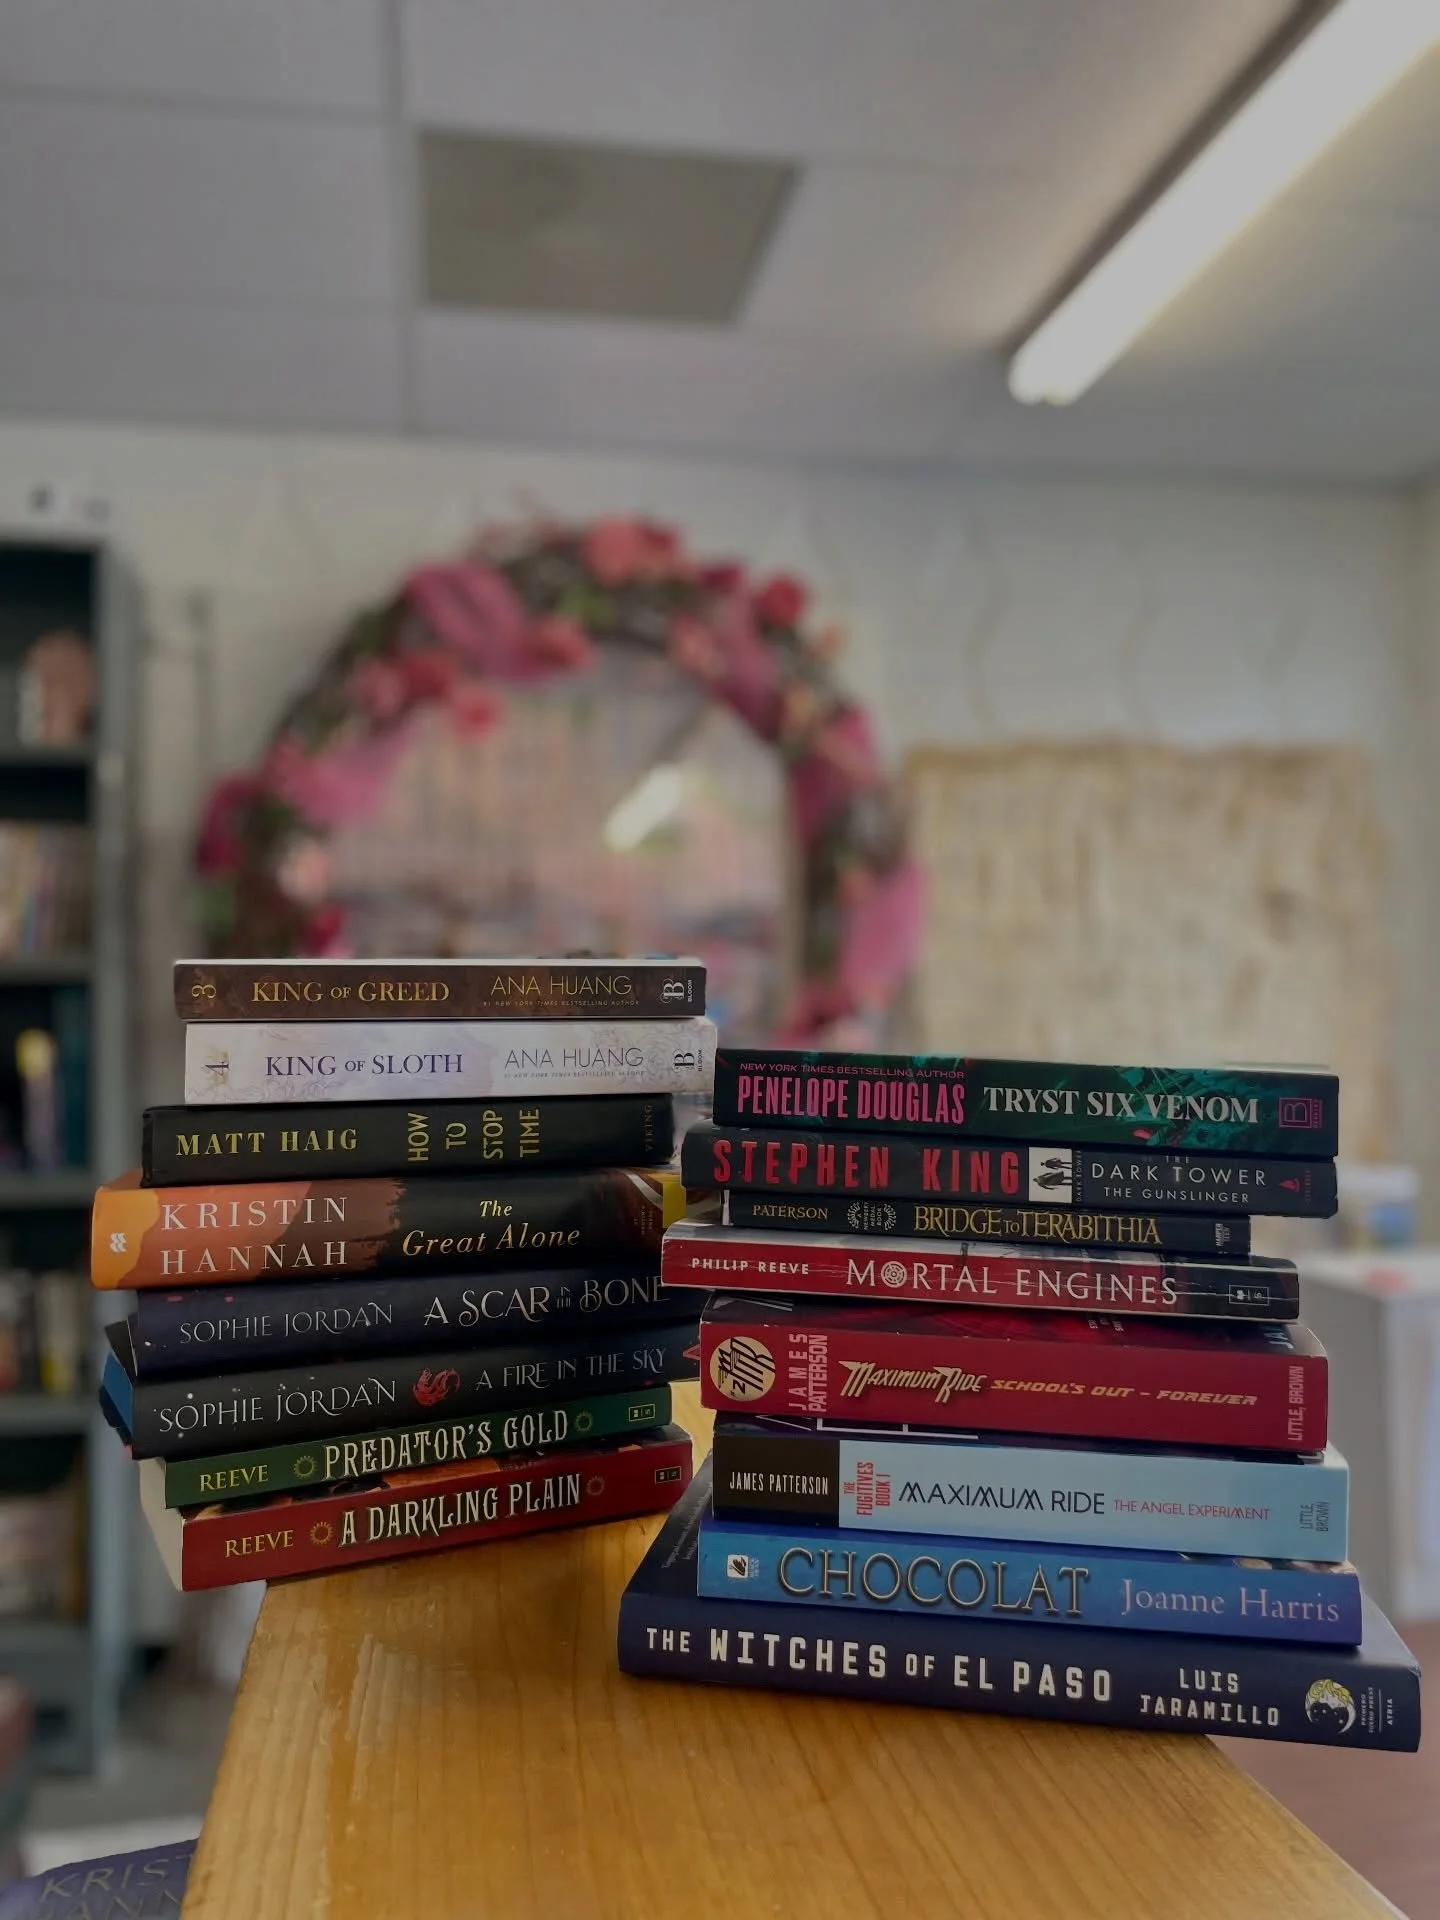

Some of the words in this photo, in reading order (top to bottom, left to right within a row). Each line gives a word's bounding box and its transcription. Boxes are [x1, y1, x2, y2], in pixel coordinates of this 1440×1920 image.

[191, 983, 216, 999] 3
[252, 981, 323, 1002] KING
[330, 986, 351, 999] OF
[358, 981, 449, 1002] GREED
[491, 976, 541, 996] ANA
[550, 975, 632, 996] HUANG
[204, 1061, 229, 1076] 4
[266, 1056, 336, 1076] KING
[344, 1060, 366, 1072] OF
[371, 1054, 462, 1075] SLOTH
[505, 1049, 553, 1069] ANA
[563, 1048, 644, 1068] HUANG
[740, 1062, 767, 1072] NEW
[769, 1063, 798, 1073] YORK
[802, 1065, 834, 1075] TIMES
[837, 1067, 914, 1078] BESTSELLING
[916, 1069, 965, 1080] AUTHOR
[737, 1075, 849, 1119] PENELOPE
[857, 1080, 965, 1126] DOUGLAS
[984, 1087, 1080, 1115] TRYST
[1086, 1090, 1136, 1118] SIX
[1144, 1094, 1259, 1124] VENOM
[176, 1132, 265, 1156] MATT
[280, 1128, 358, 1152] HAIG
[408, 1112, 429, 1162] HOW
[445, 1121, 467, 1150] TO
[483, 1109, 504, 1160] STOP
[520, 1107, 540, 1158] TIME
[712, 1139, 890, 1190] STEPHEN
[922, 1148, 1019, 1195] KING
[1092, 1162, 1158, 1181] DARK
[1172, 1166, 1266, 1186] TOWER
[480, 1200, 513, 1217] The
[1104, 1186, 1132, 1198] THE
[1141, 1188, 1250, 1203] GUNSLINGER
[161, 1197, 347, 1231] KRISTIN
[752, 1204, 829, 1221] PATERSON
[913, 1205, 1002, 1237] BRIDGE
[1017, 1209, 1163, 1245] TERABITHIA
[402, 1229, 488, 1257] Great
[496, 1222, 581, 1250] Alone
[160, 1241, 347, 1275] HANNAH
[692, 1257, 748, 1272] PHILIP
[758, 1260, 809, 1275] REEVE
[846, 1258, 998, 1294] MORTAL
[1016, 1267, 1178, 1305] ENGINES
[424, 1296, 450, 1326] A
[458, 1286, 550, 1327] SCAR
[580, 1276, 670, 1313] BONE
[180, 1315, 273, 1345] SOPHIE
[284, 1302, 392, 1338] JORDAN
[475, 1369, 494, 1392] A
[503, 1362, 550, 1389] FIRE
[557, 1358, 577, 1380] IN
[585, 1352, 625, 1376] THE
[632, 1348, 667, 1374] SKY
[788, 1333, 808, 1411] JAMES
[808, 1334, 828, 1413] PATTERSON
[838, 1360, 942, 1398] MAXIMUM
[933, 1366, 988, 1404] RIDE
[990, 1378, 1086, 1395] SCHOOL'S
[1090, 1386, 1134, 1399] OUT
[1156, 1390, 1258, 1407] FOREVER
[1288, 1365, 1304, 1404] BROWN
[159, 1396, 264, 1433] SOPHIE
[277, 1378, 396, 1422] JORDAN
[200, 1464, 269, 1492] REEVE
[321, 1420, 493, 1482] PREDATOR'S
[503, 1409, 569, 1450] GOLD
[730, 1471, 764, 1492] JAMES
[769, 1473, 829, 1496] PATTERSON
[844, 1481, 855, 1495] THE
[856, 1462, 874, 1517] FUGITIVES
[875, 1481, 890, 1506] BOOK
[898, 1481, 1044, 1511] MAXIMUM
[1051, 1489, 1105, 1515] RIDE
[225, 1530, 294, 1558] REEVE
[338, 1511, 357, 1548] A
[368, 1487, 499, 1541] DARKLING
[506, 1473, 582, 1519] PLAIN
[1114, 1499, 1137, 1512] THE
[1140, 1501, 1185, 1516] ANGEL
[1188, 1503, 1271, 1521] EXPERIMENT
[1316, 1501, 1330, 1532] BROWN
[778, 1547, 1089, 1617] CHOCOLAT
[1121, 1578, 1226, 1616] Joanne
[1240, 1585, 1340, 1623] Harris
[646, 1627, 691, 1653] THE
[710, 1627, 887, 1679] WITCHES
[905, 1653, 936, 1678] OF
[953, 1654, 994, 1690] EL
[1012, 1659, 1112, 1702] PASO
[1179, 1667, 1240, 1695] LUIS
[1140, 1694, 1280, 1727] JARAMILLO
